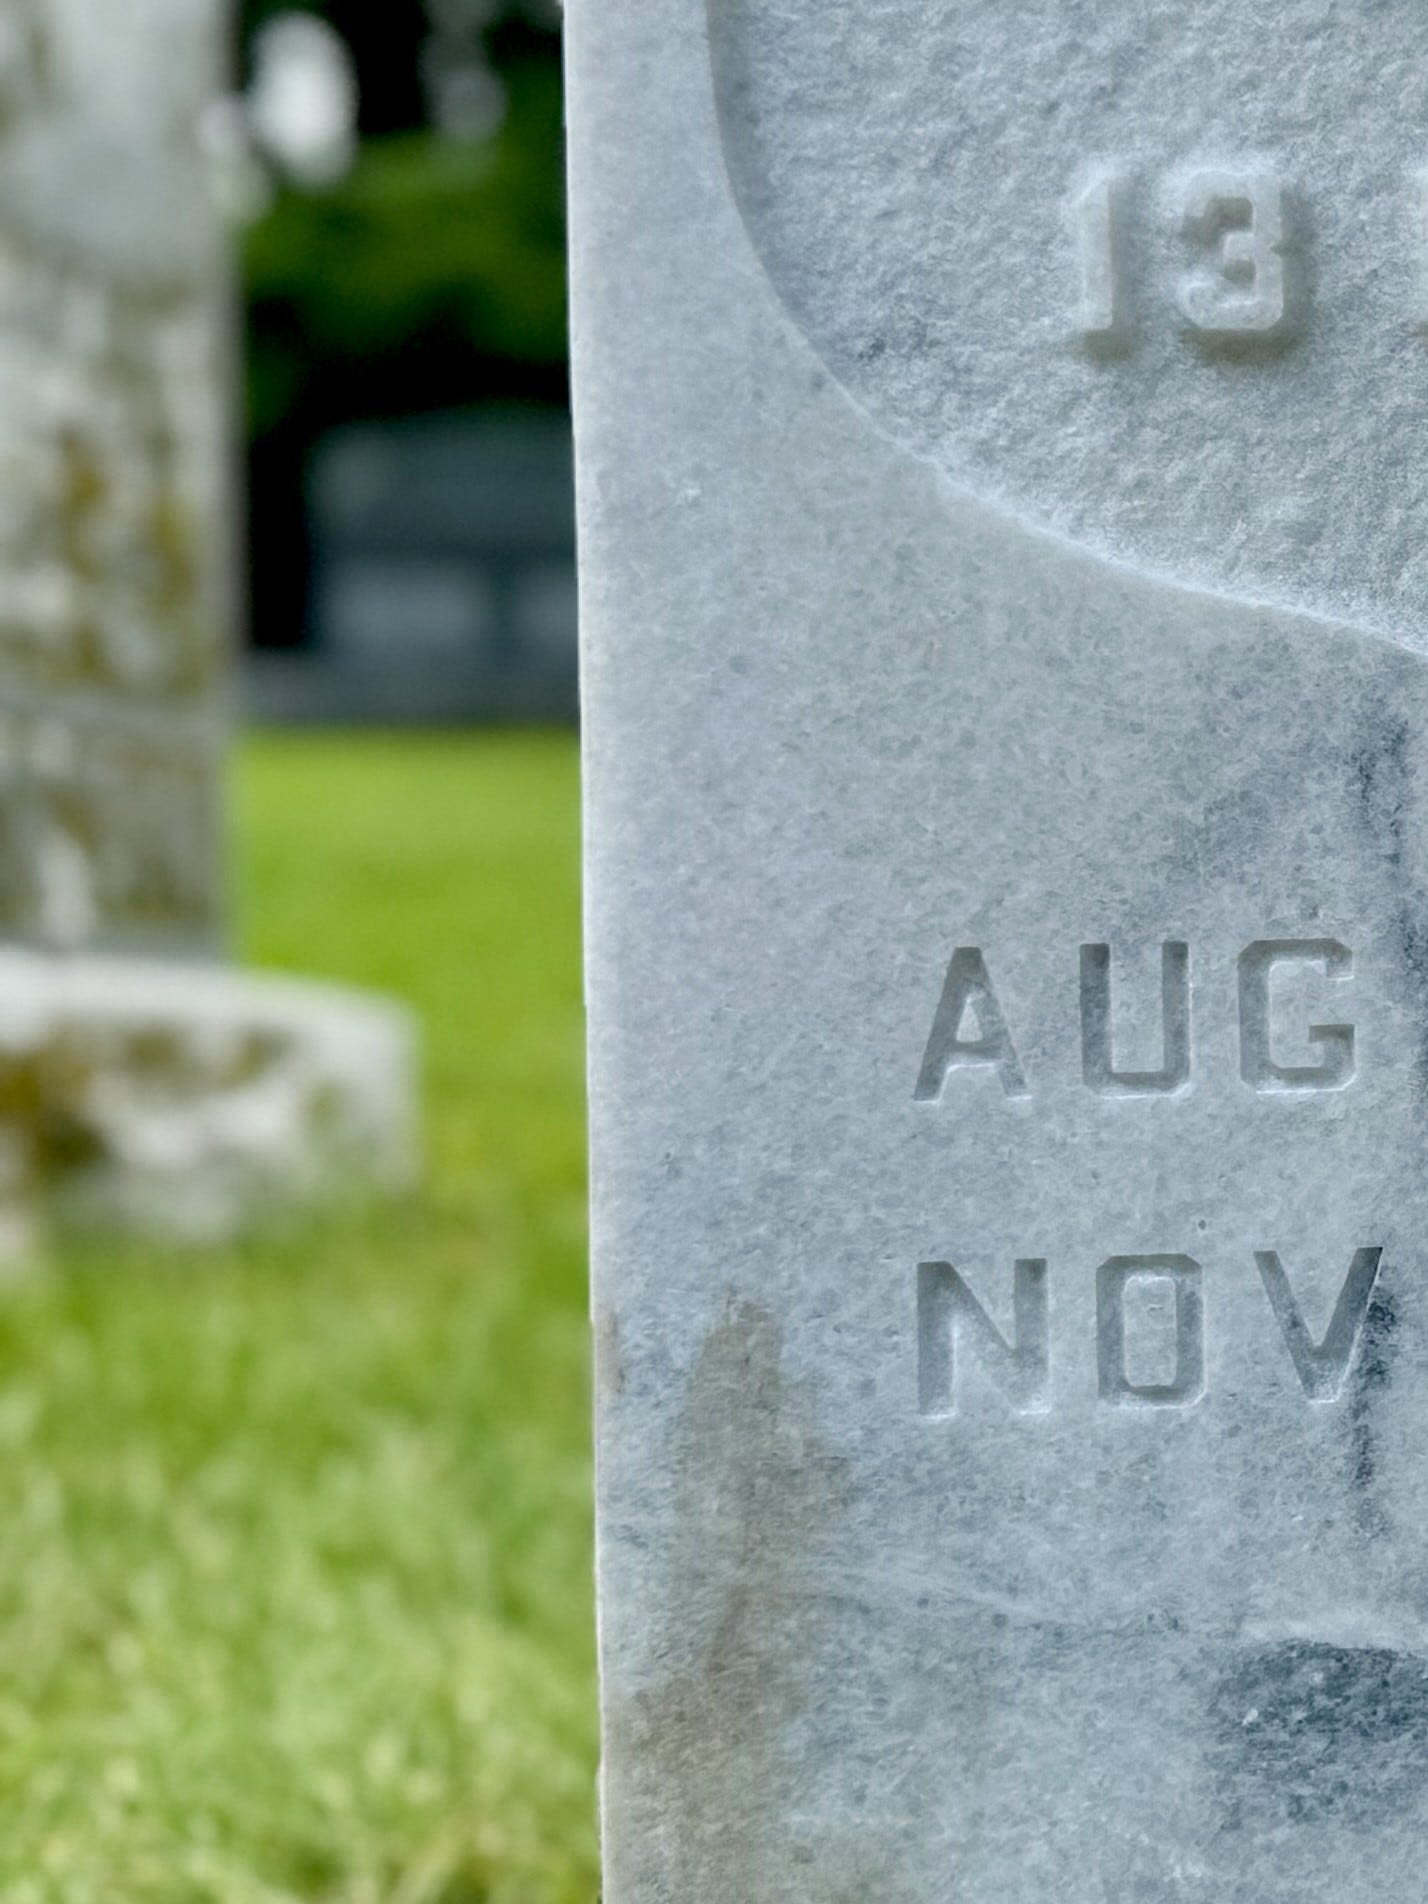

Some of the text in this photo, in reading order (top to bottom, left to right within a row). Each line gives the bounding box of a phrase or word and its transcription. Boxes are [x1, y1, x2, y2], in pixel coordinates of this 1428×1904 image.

[1073, 160, 1288, 334] 13
[912, 934, 1360, 1102] AUG
[915, 1243, 1385, 1418] NOV
